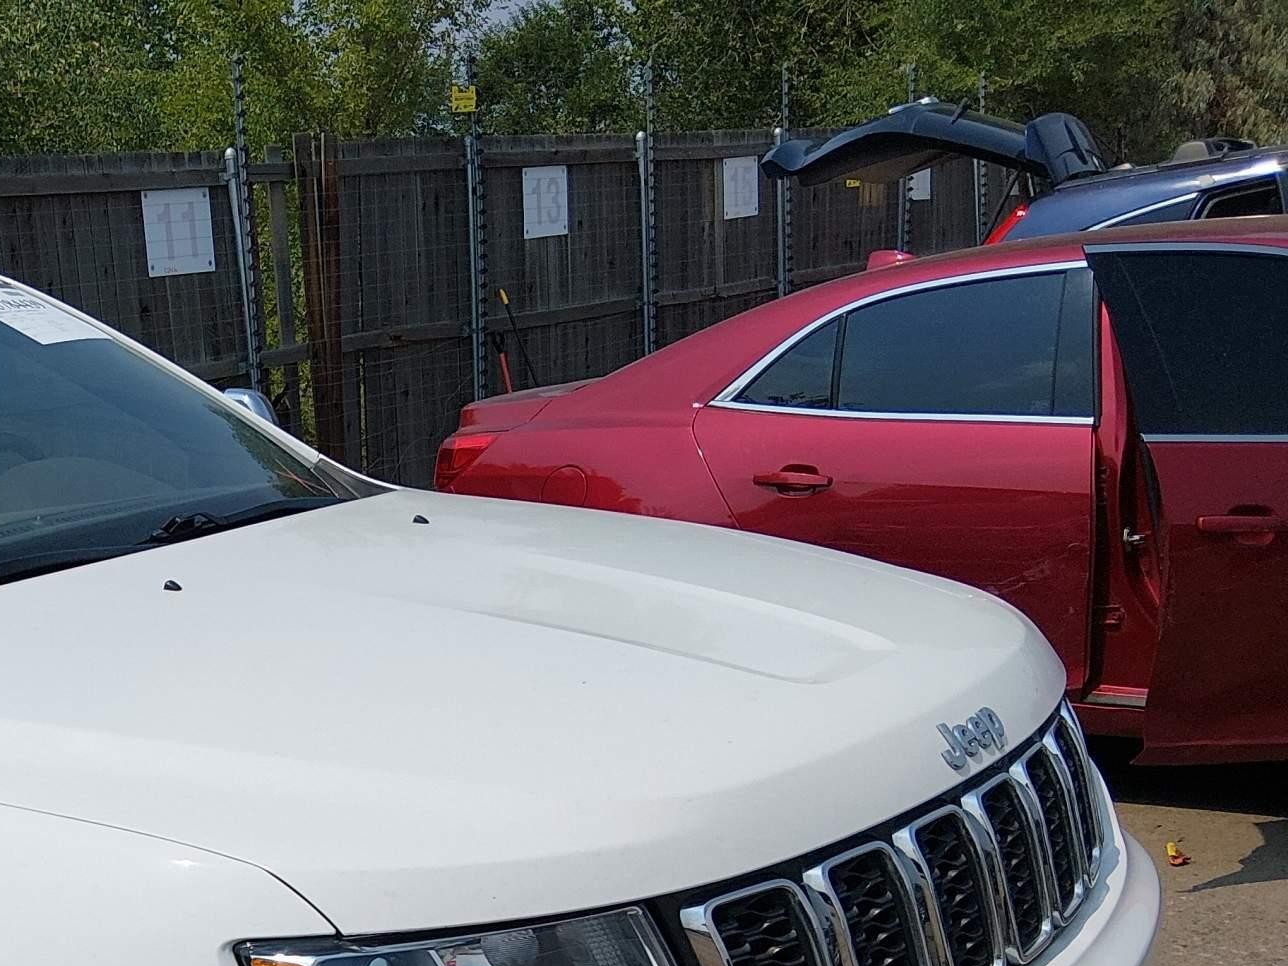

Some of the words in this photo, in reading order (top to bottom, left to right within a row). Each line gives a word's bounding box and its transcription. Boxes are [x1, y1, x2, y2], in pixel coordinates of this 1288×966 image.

[532, 176, 561, 226] 13
[157, 202, 199, 261] 11
[935, 706, 1005, 771] Jeep
